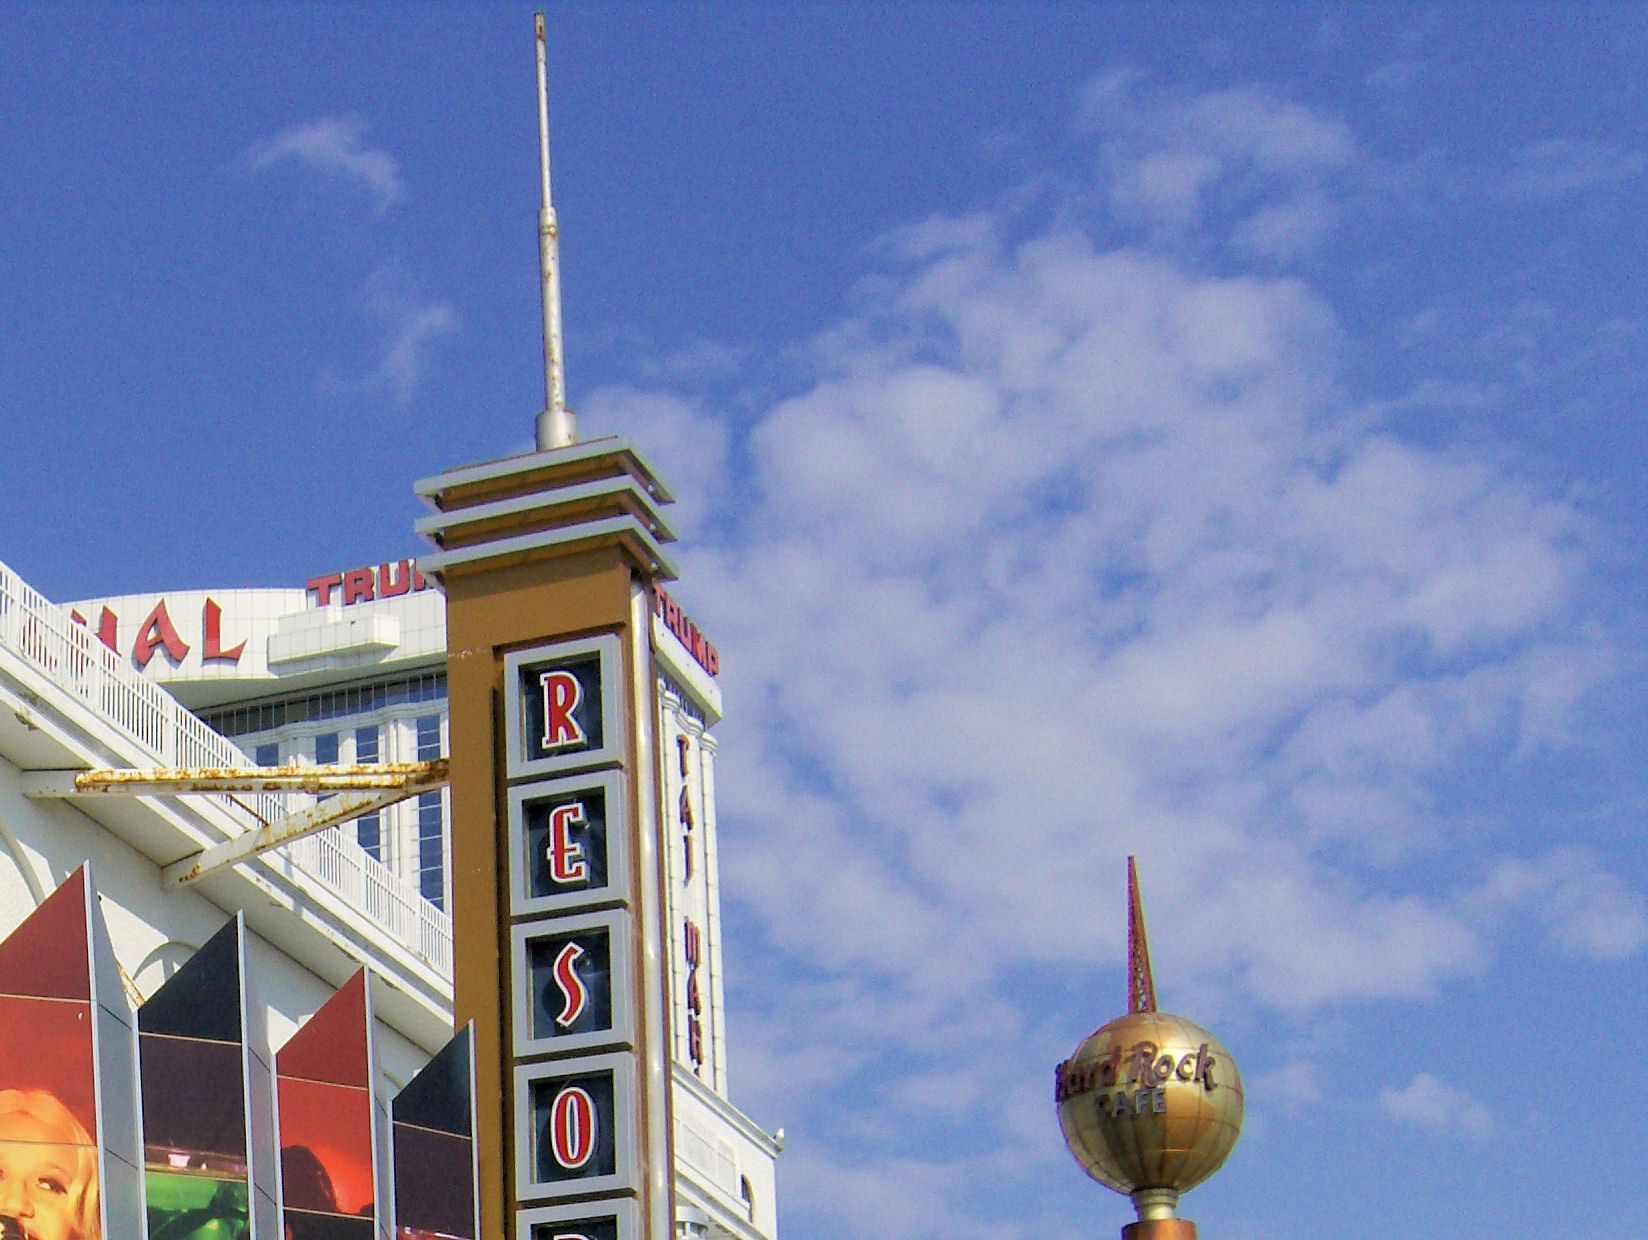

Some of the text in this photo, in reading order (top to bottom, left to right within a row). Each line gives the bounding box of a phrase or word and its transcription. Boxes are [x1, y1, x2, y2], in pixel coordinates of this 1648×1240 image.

[306, 558, 433, 608] TRU
[653, 583, 721, 677] TRUMP
[684, 917, 704, 1077] MAH
[1125, 1040, 1219, 1091] Rock
[1095, 1088, 1167, 1117] CAFE
